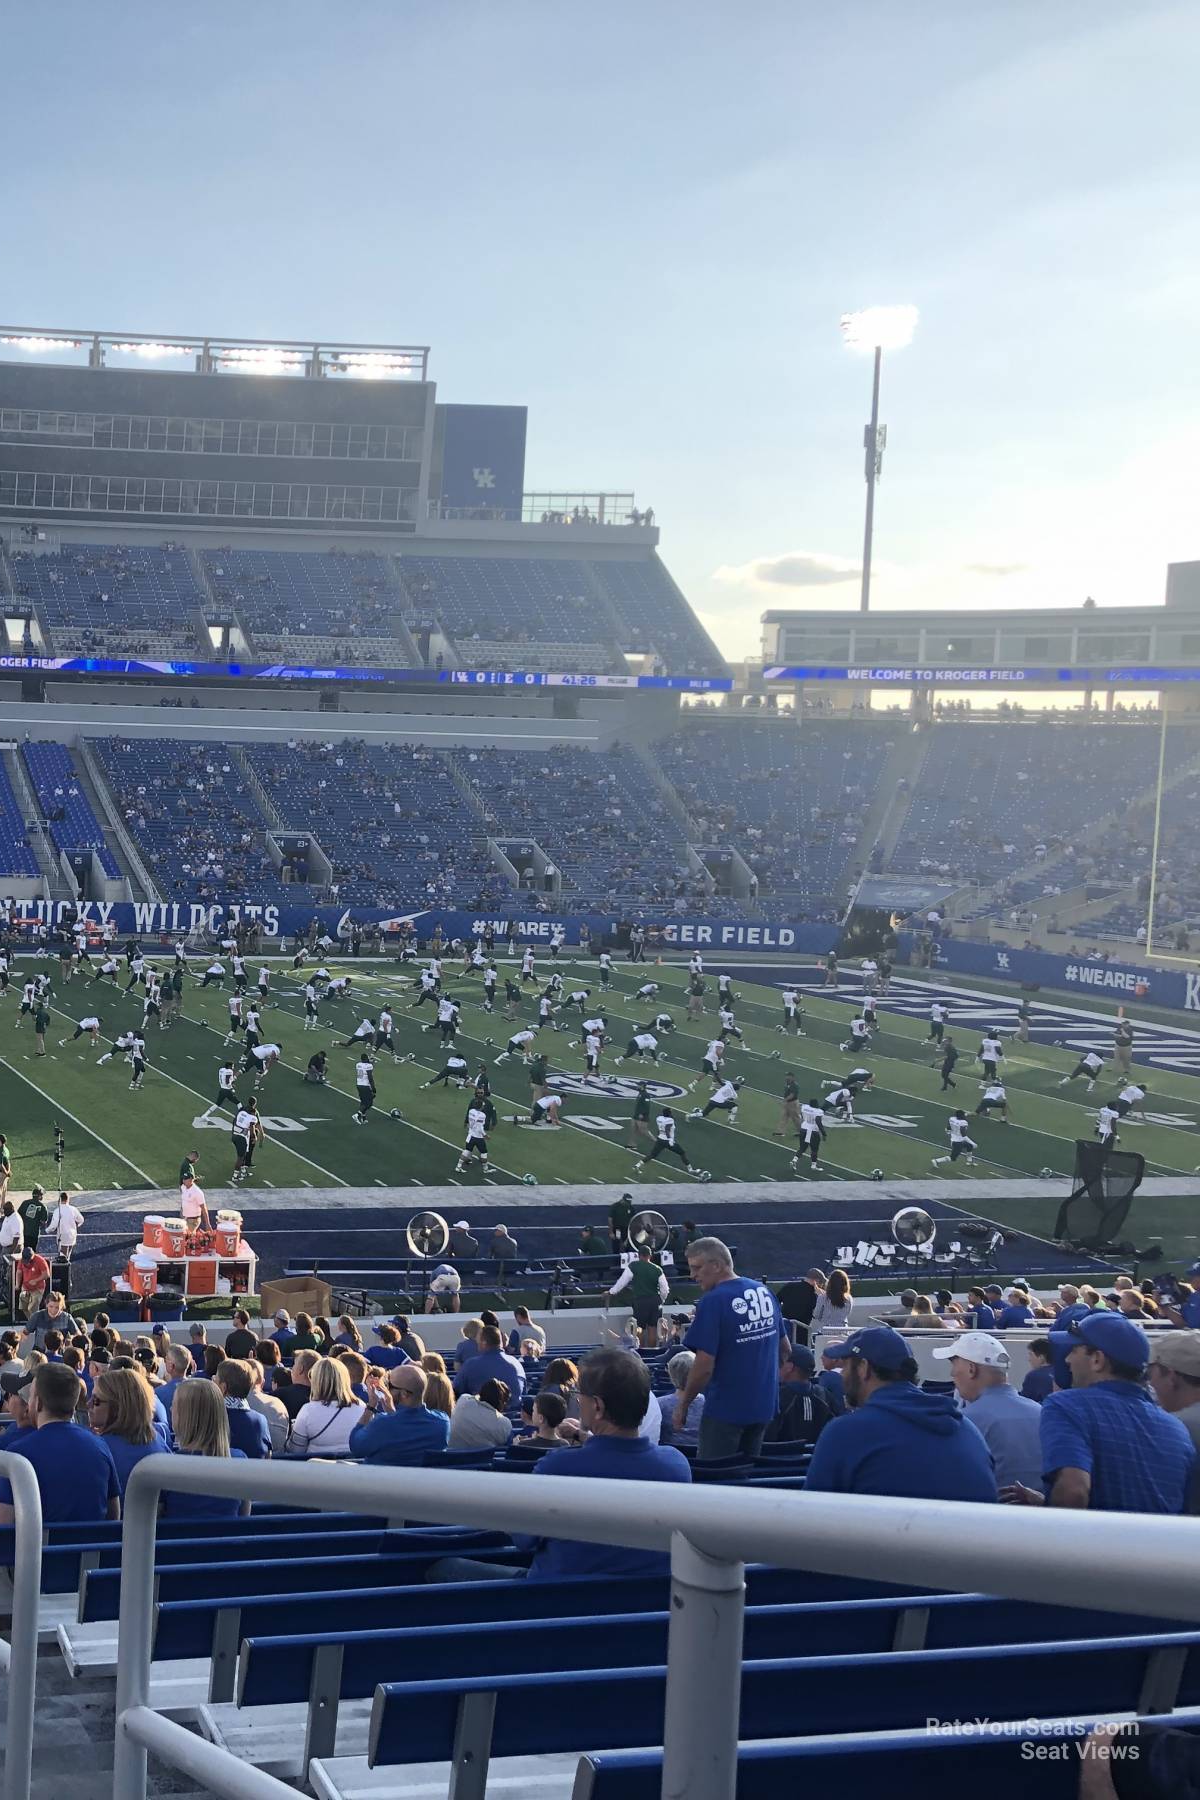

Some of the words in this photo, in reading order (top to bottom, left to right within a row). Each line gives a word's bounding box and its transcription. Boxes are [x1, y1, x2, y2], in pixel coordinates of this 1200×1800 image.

[561, 676, 597, 687] 41:26
[847, 669, 913, 681] WELCOME
[915, 670, 933, 681] TO
[935, 670, 988, 681] KROGER
[989, 670, 1025, 681] FIELD
[722, 926, 796, 947] FIELD
[743, 1286, 774, 1321] 36
